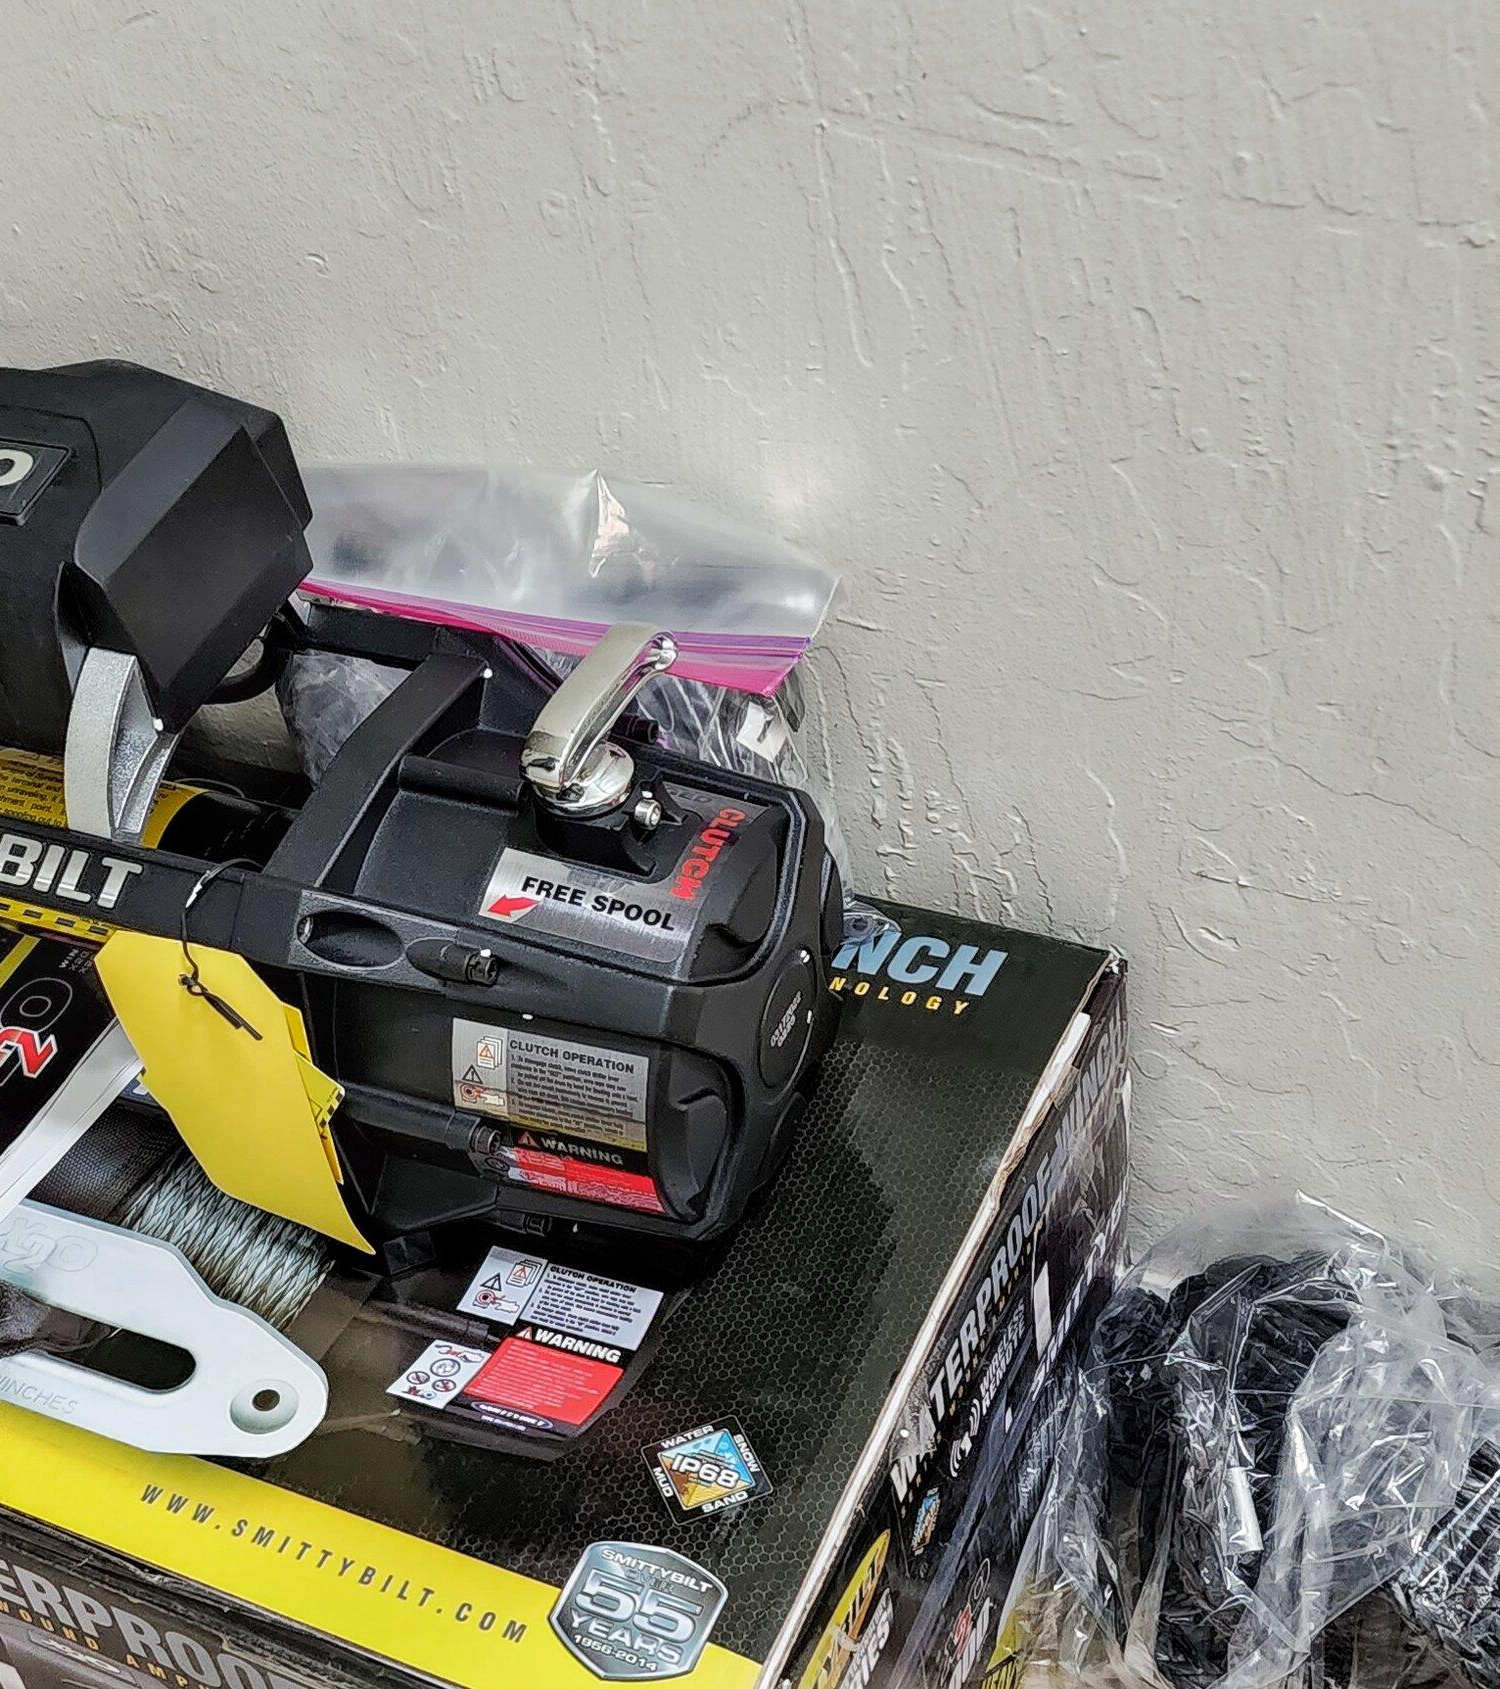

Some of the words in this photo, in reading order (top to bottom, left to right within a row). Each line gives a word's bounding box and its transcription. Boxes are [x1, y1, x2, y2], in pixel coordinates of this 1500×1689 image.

[671, 807, 746, 900] CLUTCH
[521, 876, 586, 906] FREE
[591, 895, 674, 931] SPOOL
[831, 930, 1009, 997] NCH
[829, 976, 969, 1015] NOLOGY
[509, 1039, 559, 1059] CLUTCH
[562, 1050, 635, 1074] OPERATION
[540, 1136, 624, 1166] WARNING
[549, 1265, 585, 1280] CLUTCH
[586, 1274, 637, 1294] OPERATION
[534, 1328, 622, 1364] WARNING
[890, 1150, 1052, 1503] WTERPROOF
[980, 1300, 1025, 1396] WIRELESS
[981, 1317, 1026, 1416] REMOTE
[660, 1425, 714, 1449] WATER
[733, 1434, 761, 1473] SNOW
[652, 1466, 675, 1498] MUD
[672, 1454, 741, 1490] IP68
[701, 1490, 749, 1513] SAND
[140, 1483, 529, 1644] WWW.SMITTYBILT.COM
[601, 1548, 713, 1595] SMITTYBILT
[574, 1567, 704, 1645] 55
[569, 1607, 684, 1665] YEARS
[573, 1633, 658, 1672] 1956-2014
